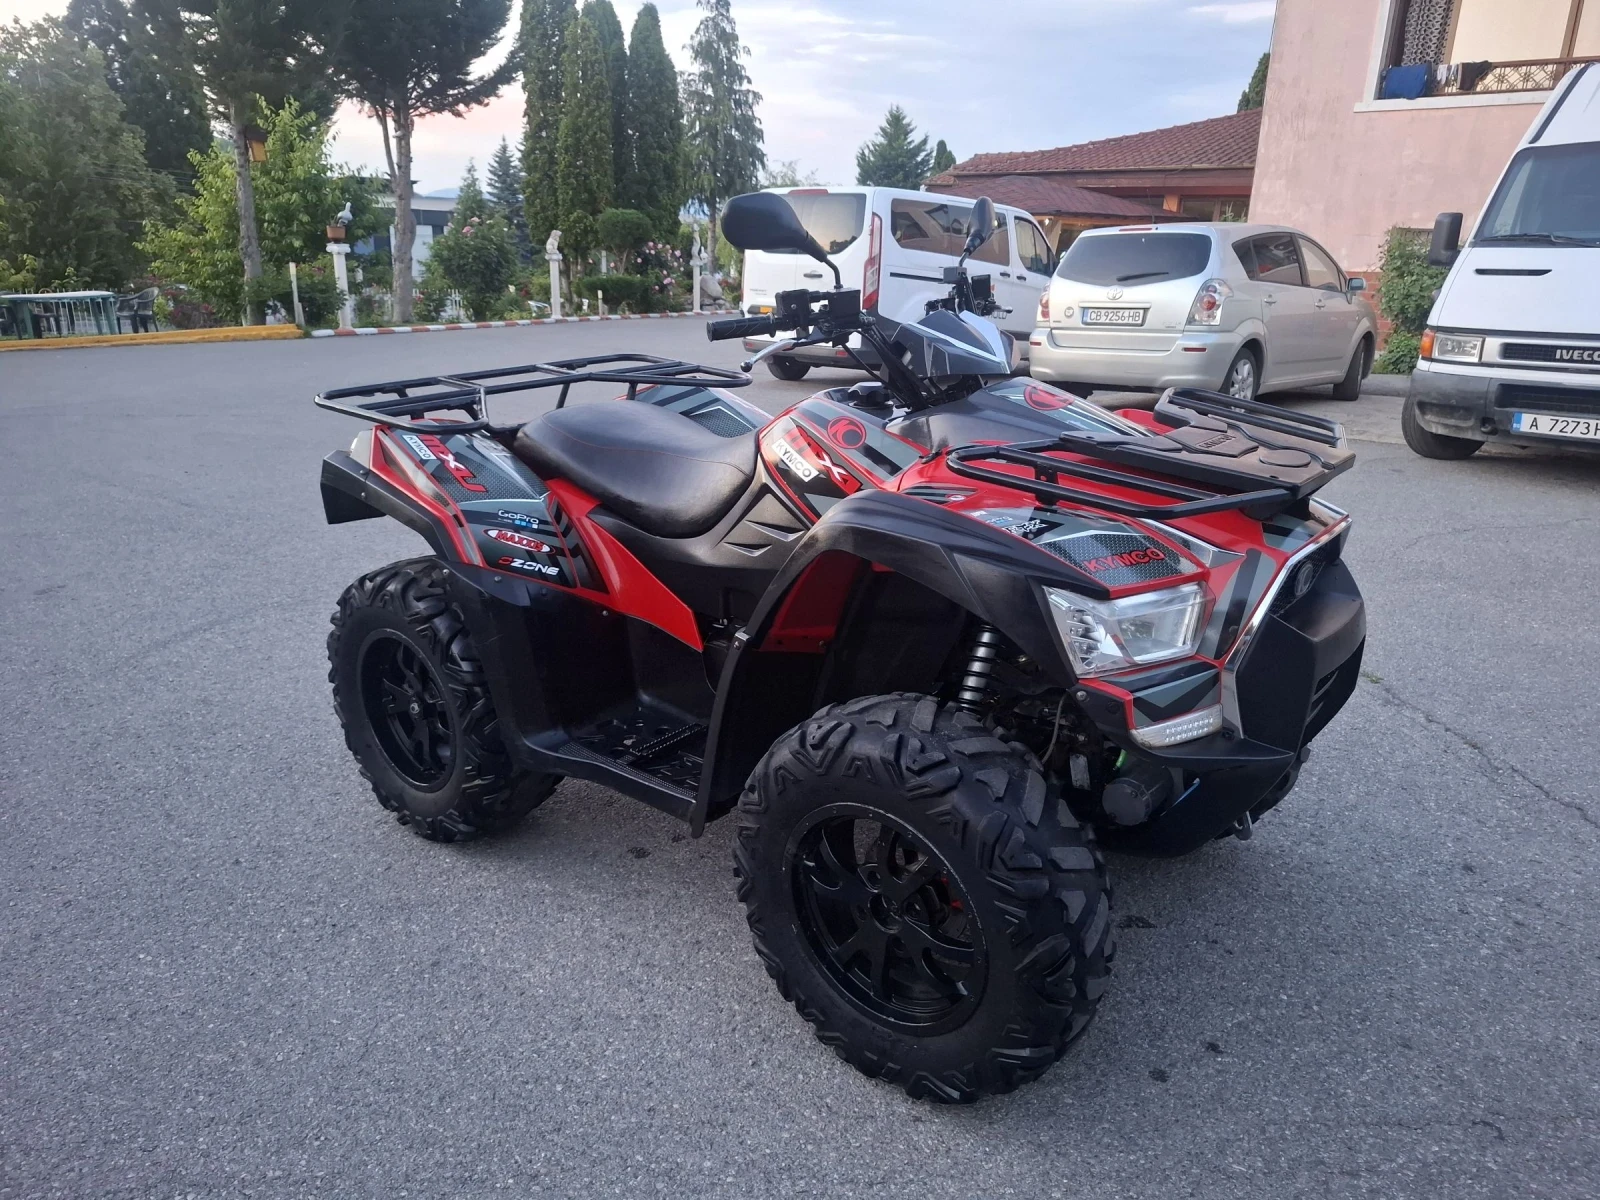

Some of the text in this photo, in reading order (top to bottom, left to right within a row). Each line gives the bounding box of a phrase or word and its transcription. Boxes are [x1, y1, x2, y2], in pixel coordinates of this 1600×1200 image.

[1089, 310, 1141, 322] CB 9256 HB
[1529, 417, 1539, 431] A
[1548, 418, 1591, 436] 7273
[406, 435, 432, 459] KYMCO
[776, 440, 812, 478] KYMCO
[498, 509, 539, 524] GoPro
[495, 530, 544, 552] MAXXIS
[1082, 547, 1165, 573] KYMCO
